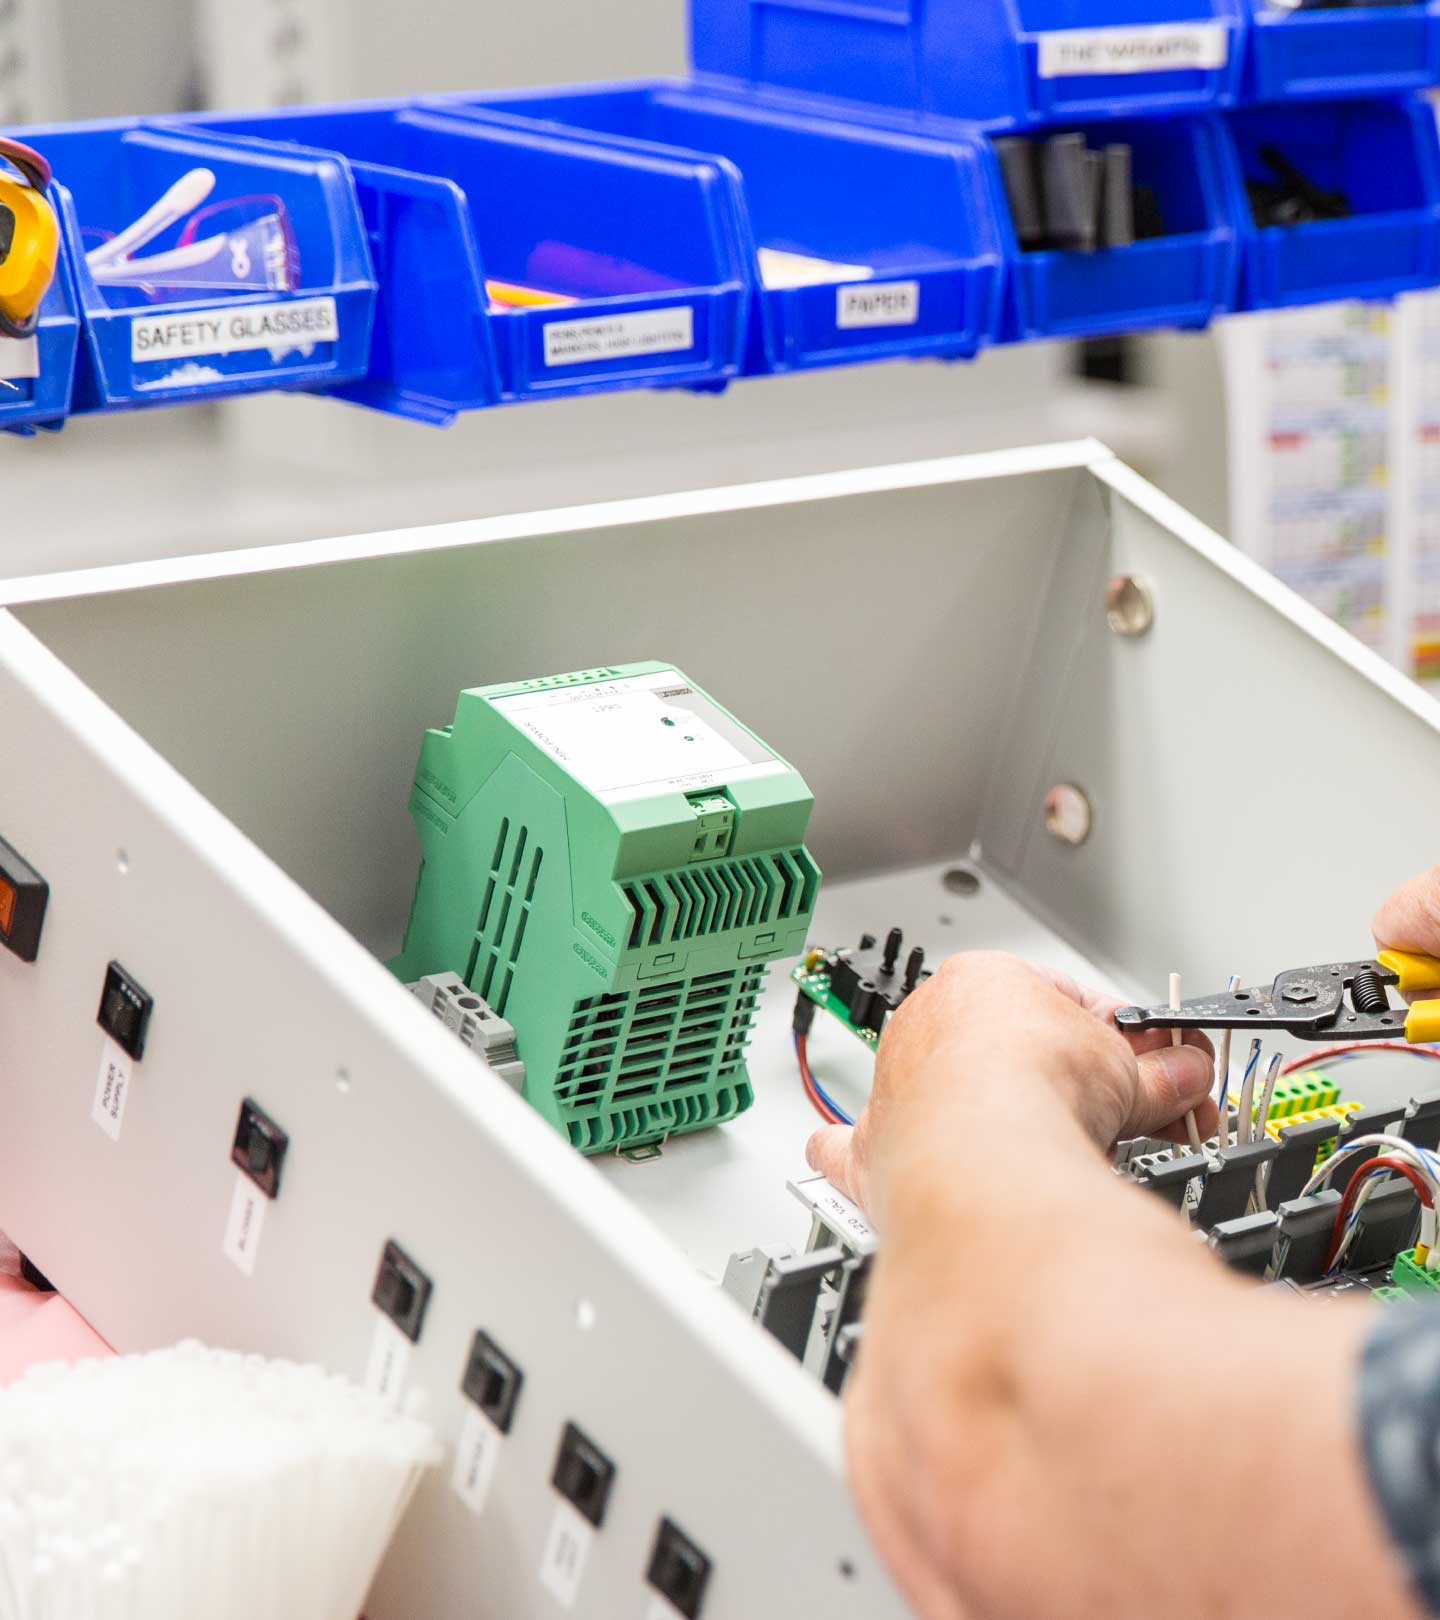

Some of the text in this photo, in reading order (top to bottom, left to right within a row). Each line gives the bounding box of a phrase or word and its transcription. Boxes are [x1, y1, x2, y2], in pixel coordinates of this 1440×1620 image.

[847, 292, 910, 315] PAPER
[136, 307, 331, 351] SAFETY GLASSES
